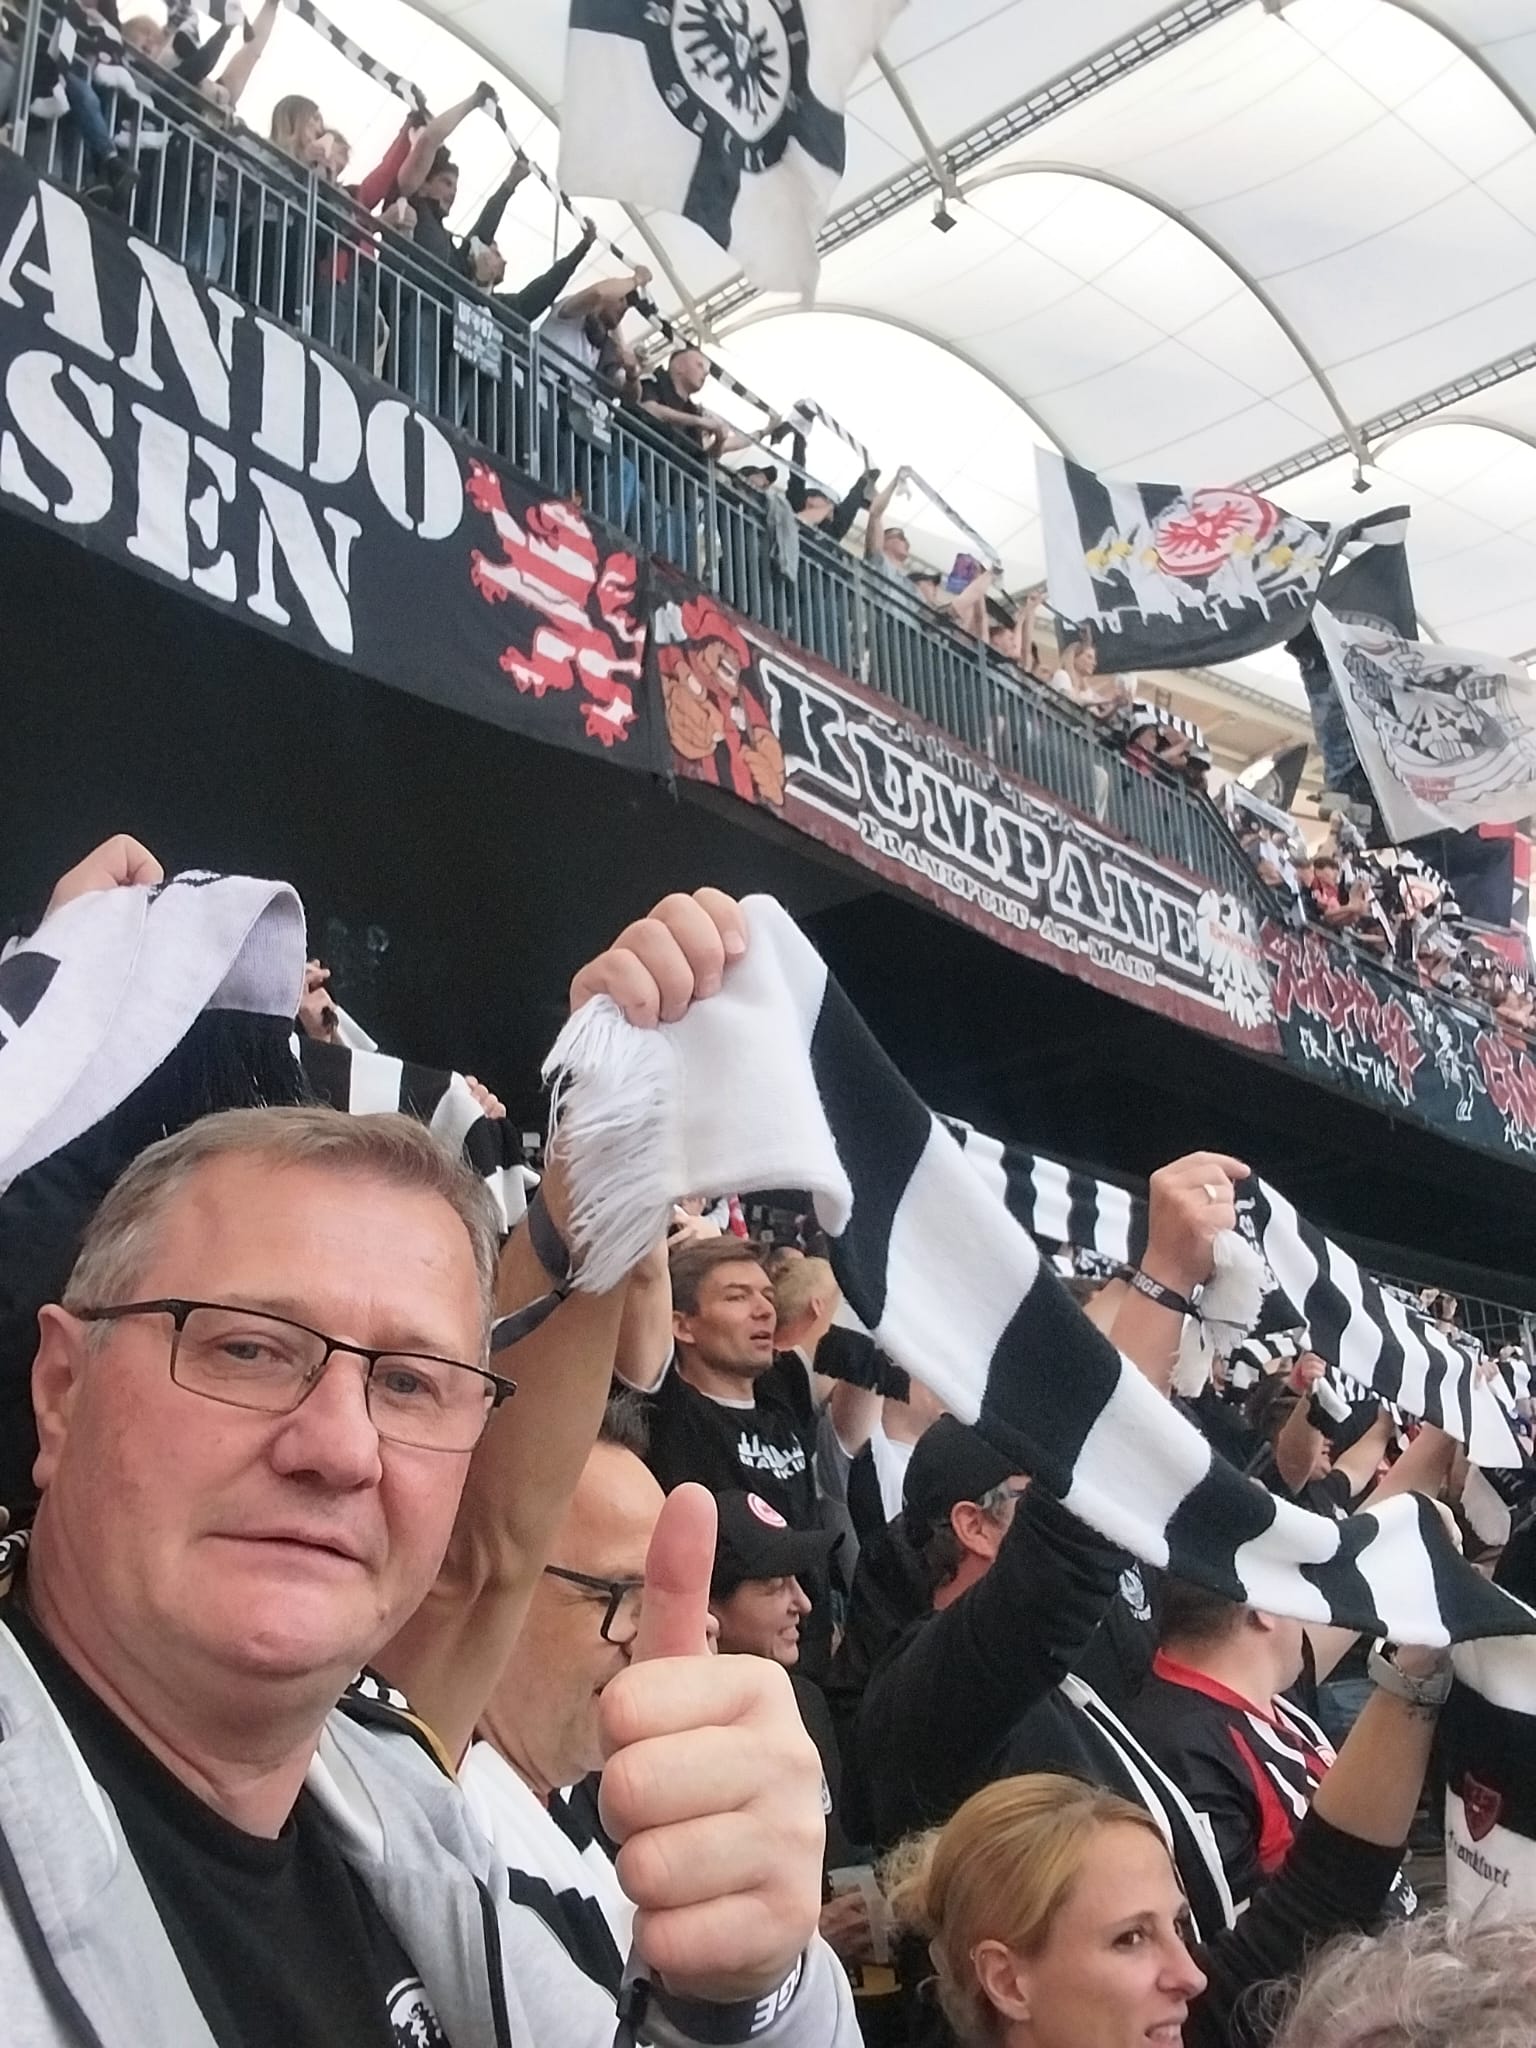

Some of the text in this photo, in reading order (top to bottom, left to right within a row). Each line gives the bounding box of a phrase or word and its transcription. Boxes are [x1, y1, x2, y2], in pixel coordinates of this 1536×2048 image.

[0, 179, 463, 540] ANDO
[0, 350, 362, 654] SEN
[759, 657, 1205, 977] KUMPANE
